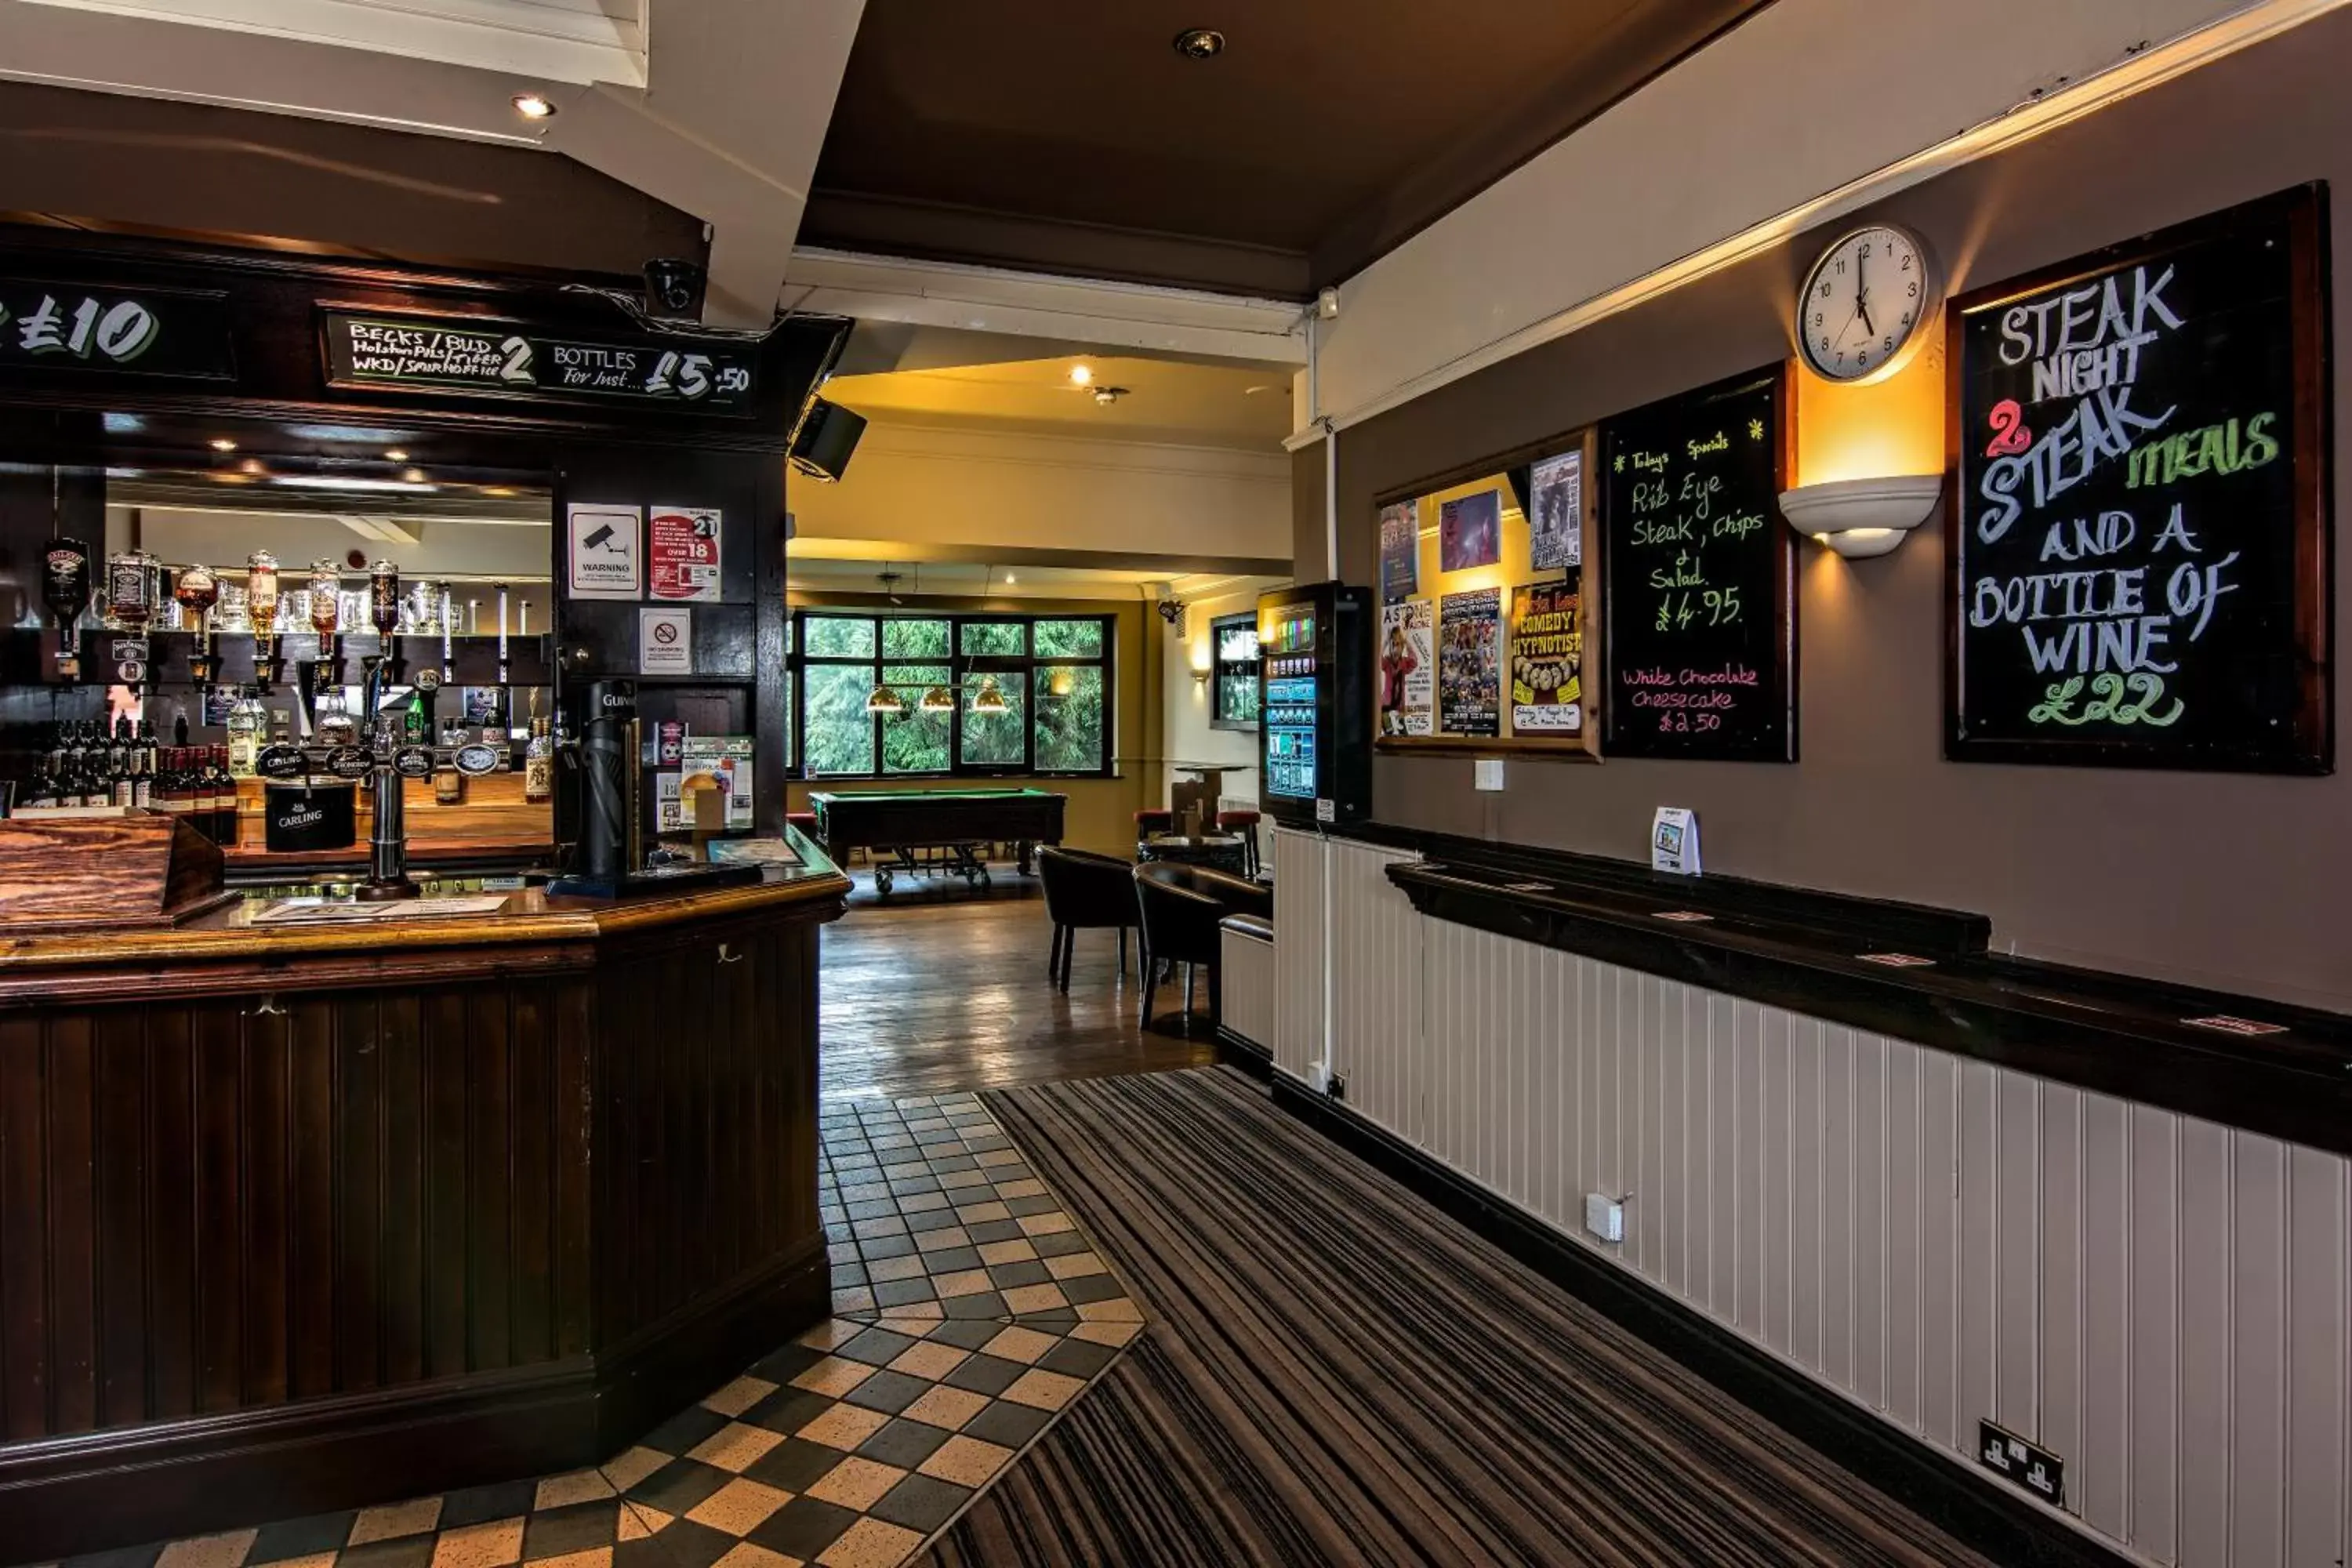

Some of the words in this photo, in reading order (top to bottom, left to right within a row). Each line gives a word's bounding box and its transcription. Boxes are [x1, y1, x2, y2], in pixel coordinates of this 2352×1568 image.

[1857, 244, 1870, 260] 12
[1886, 243, 1893, 257] 1
[1835, 260, 1846, 274] 11
[1901, 255, 1911, 271] 2
[1820, 282, 1831, 298] 10
[1907, 282, 1917, 297] 3
[1815, 314, 1823, 326] 9
[1901, 312, 1910, 325] 4
[1999, 263, 2187, 365] STEAK
[17, 294, 160, 363] £10
[1822, 337, 1829, 350] 8
[1884, 336, 1893, 351] 5
[500, 336, 537, 386] 2
[554, 347, 636, 370] BOTTLES
[1837, 353, 1844, 365] 7
[1858, 350, 1867, 365] 6
[2032, 330, 2158, 402] NIGHT
[564, 367, 591, 384] For
[1986, 399, 2032, 457] 2
[1632, 452, 1670, 473] Todays
[1687, 431, 1730, 460] Specials
[2125, 412, 2278, 489] MEALS
[1977, 387, 2177, 544] STEAK
[1632, 477, 1670, 514] Rib
[1679, 472, 1723, 520] Eye
[694, 519, 717, 535] 21
[1713, 509, 1764, 540] Chips
[2040, 511, 2134, 562] AND
[2151, 503, 2201, 552] A
[689, 543, 708, 557] 18
[583, 564, 630, 573] WARNING
[1970, 566, 2149, 627] BOTTLE
[2167, 551, 2240, 641] OF
[1520, 612, 1572, 634] COMEDY
[1512, 633, 1581, 656] HYPNOTIST
[2021, 615, 2178, 673] WINE
[1622, 666, 1676, 686] White
[1679, 662, 1759, 686] Chocolate
[1632, 690, 1737, 710] Cheesecake
[2027, 672, 2184, 726] £22
[1659, 710, 1721, 733] £2.50
[279, 810, 322, 828] CARLING
